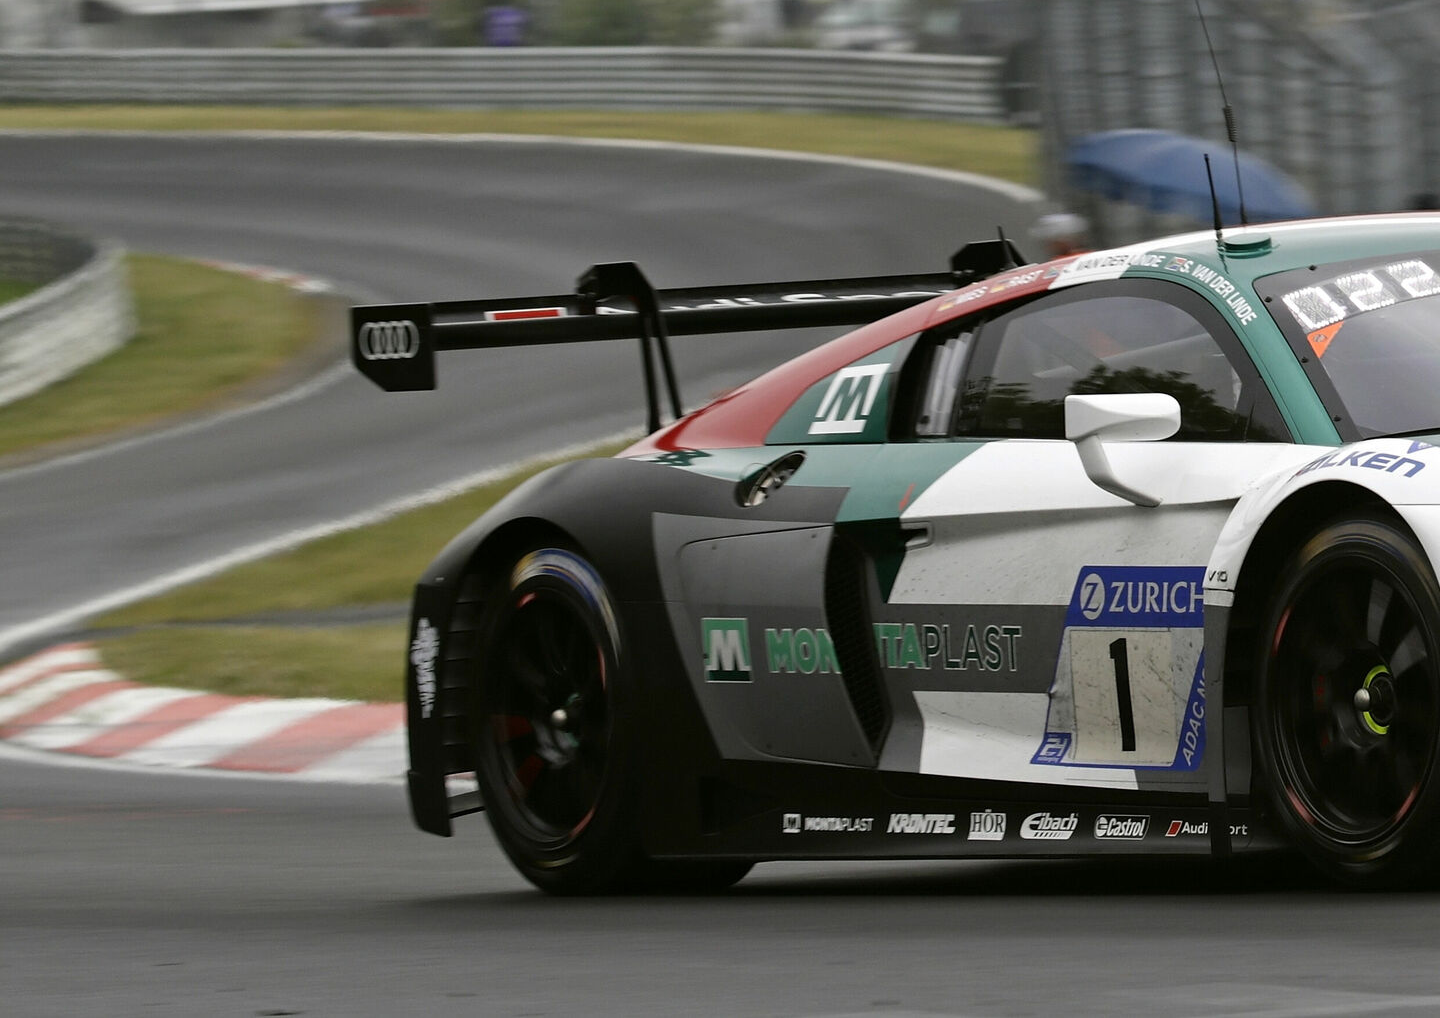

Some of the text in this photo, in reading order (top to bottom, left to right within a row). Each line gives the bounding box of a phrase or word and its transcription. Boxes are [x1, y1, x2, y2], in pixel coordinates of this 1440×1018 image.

[1191, 264, 1220, 285] VAN
[1209, 275, 1235, 298] DER
[1226, 292, 1258, 326] LINDE
[1109, 582, 1204, 613] ZURICH
[1109, 638, 1136, 752] 1
[804, 816, 874, 832] MONTAPLAST
[886, 814, 956, 833] KRONTEC
[1020, 812, 1079, 832] Eibach
[1107, 817, 1146, 837] Castrol
[1181, 822, 1208, 834] Audi
